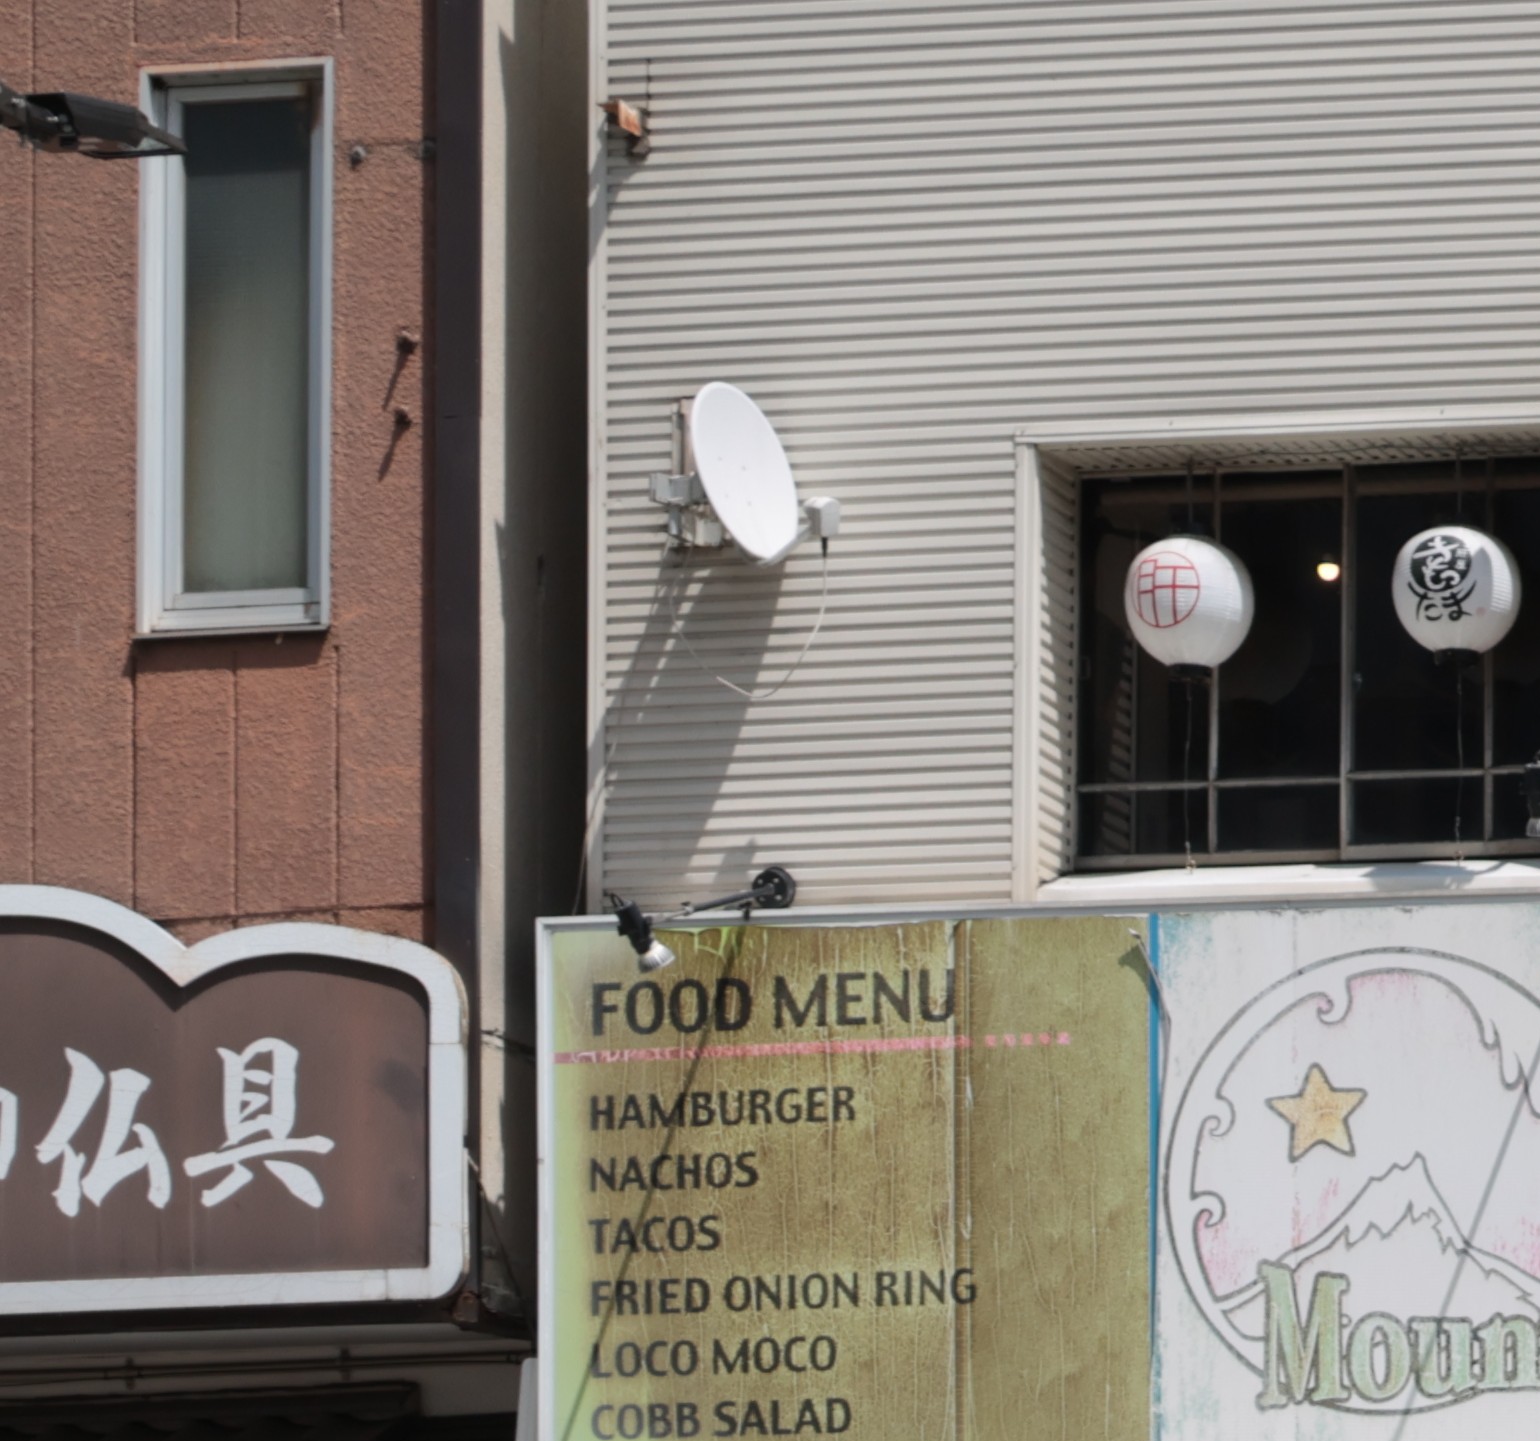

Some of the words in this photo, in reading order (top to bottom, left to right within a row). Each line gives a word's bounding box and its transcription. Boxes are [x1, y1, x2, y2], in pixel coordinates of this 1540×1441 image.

[590, 977, 751, 1037] FOOD
[773, 968, 955, 1028] MENU
[0, 1037, 335, 1218] 仏具
[589, 1084, 856, 1131] HAMBURGER
[589, 1151, 758, 1193] NACHOS
[589, 1214, 721, 1254] TACOS
[590, 1275, 709, 1316] FRIED
[725, 1272, 864, 1312] ONION
[876, 1268, 976, 1307] RING
[590, 1338, 700, 1378] LOCO
[712, 1334, 836, 1374] MOCO
[591, 1401, 701, 1440] COBB
[713, 1397, 851, 1437] SALAD
